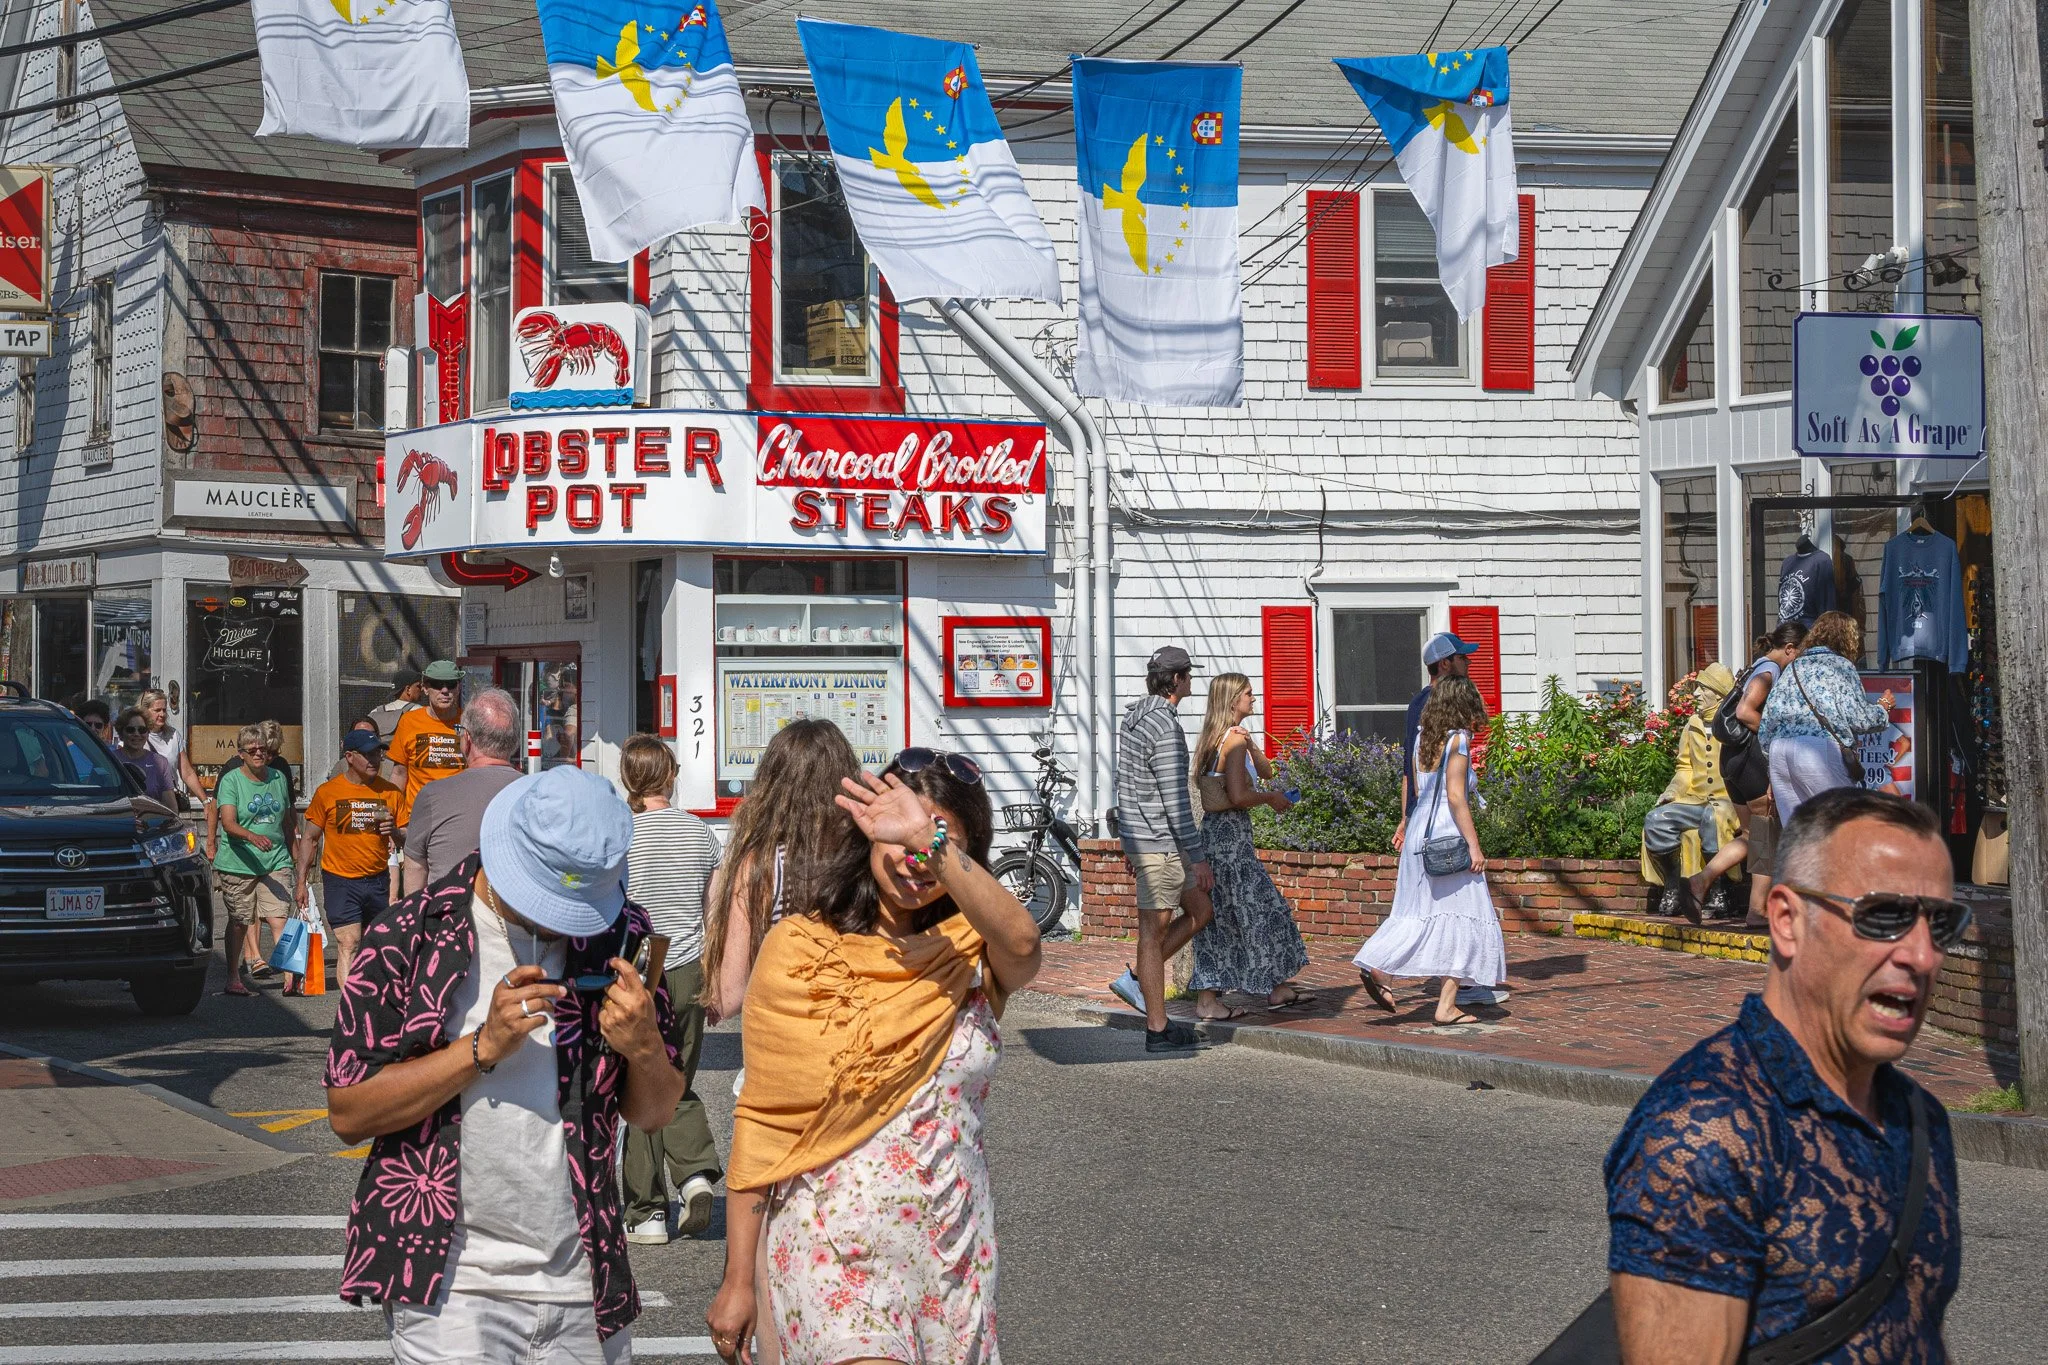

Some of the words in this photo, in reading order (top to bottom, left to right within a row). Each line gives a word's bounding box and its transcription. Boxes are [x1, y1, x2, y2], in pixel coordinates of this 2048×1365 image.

[4, 329, 41, 347] TAP
[1807, 411, 1850, 443] Soft
[1858, 417, 1881, 444] As
[1889, 417, 1900, 443] A
[1908, 412, 1968, 450] Grape
[482, 426, 724, 491] LOBSTER
[757, 423, 921, 488] Charcoal
[917, 430, 1045, 489] Broiled
[205, 487, 316, 509] MAUCLÈRE
[525, 482, 648, 530] POT
[789, 489, 1016, 534] STEAKS
[102, 625, 121, 643] LIVE
[220, 628, 258, 645] Miller
[213, 647, 238, 658] HIGH
[240, 649, 262, 659] LIFE
[729, 673, 828, 689] WATERFRONT
[833, 673, 887, 689] DINING
[689, 695, 705, 759] 321
[429, 736, 455, 744] Riders
[728, 750, 755, 765] FULL
[862, 750, 888, 764] DAY!
[1858, 747, 1895, 764] TEES!
[50, 895, 82, 911] 1JMA
[86, 895, 102, 910] 87
